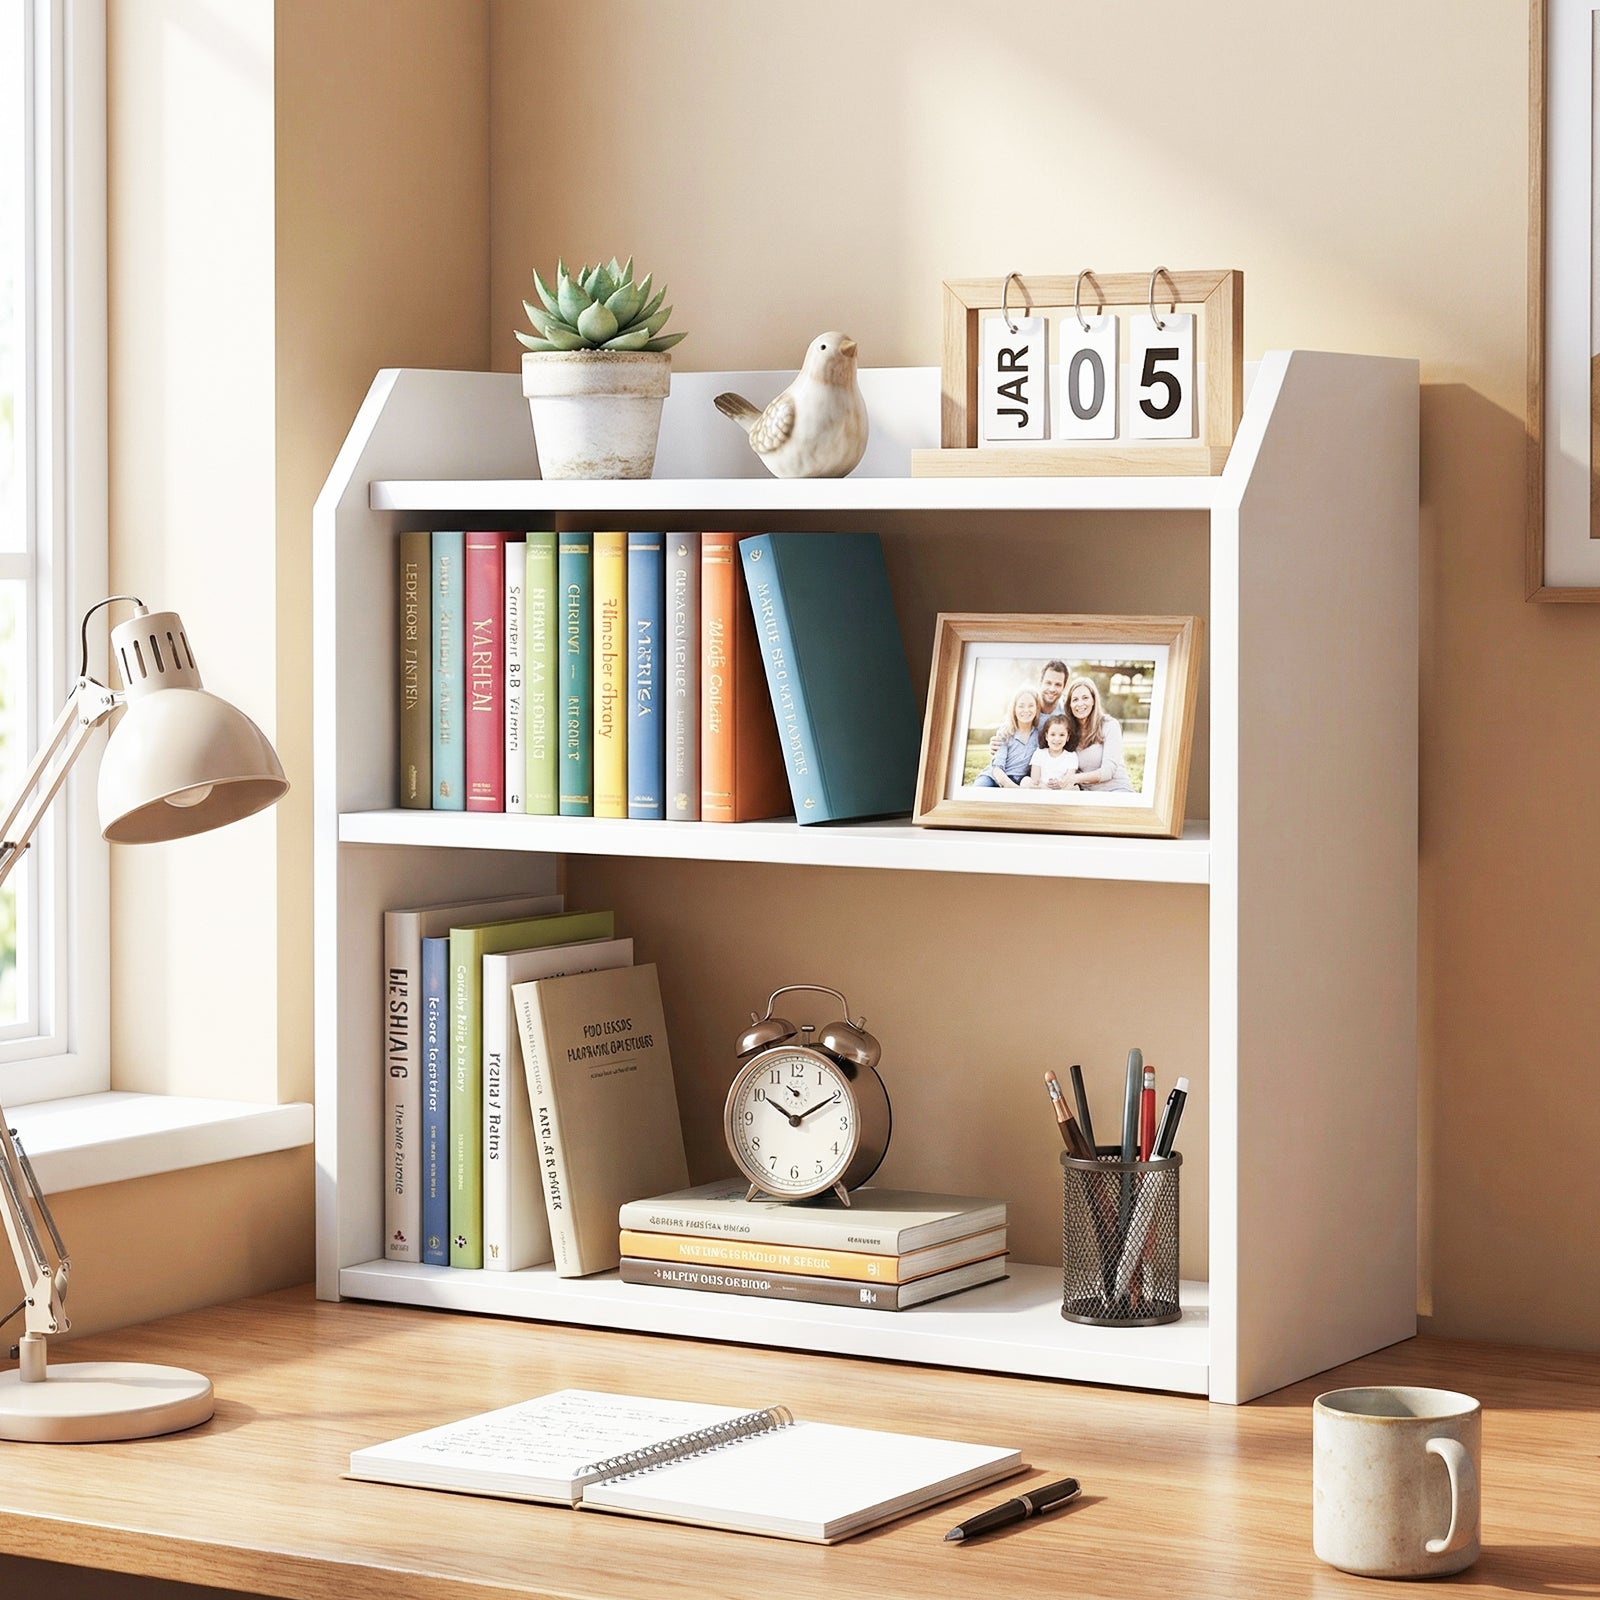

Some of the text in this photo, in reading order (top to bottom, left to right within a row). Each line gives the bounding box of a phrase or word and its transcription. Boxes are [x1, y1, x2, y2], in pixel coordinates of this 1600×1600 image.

[997, 345, 1029, 428] JAR
[770, 1070, 781, 1085] 11
[791, 1063, 804, 1078] 12
[817, 1071, 823, 1086] 1
[754, 1088, 766, 1102] 10
[832, 1089, 842, 1104] 2
[744, 1111, 754, 1126] 9
[839, 1116, 848, 1131] 3
[751, 1136, 761, 1151] 8
[830, 1140, 839, 1156] 4
[769, 1155, 778, 1170] 7
[814, 1160, 823, 1175] 5
[790, 1165, 799, 1179] 6
